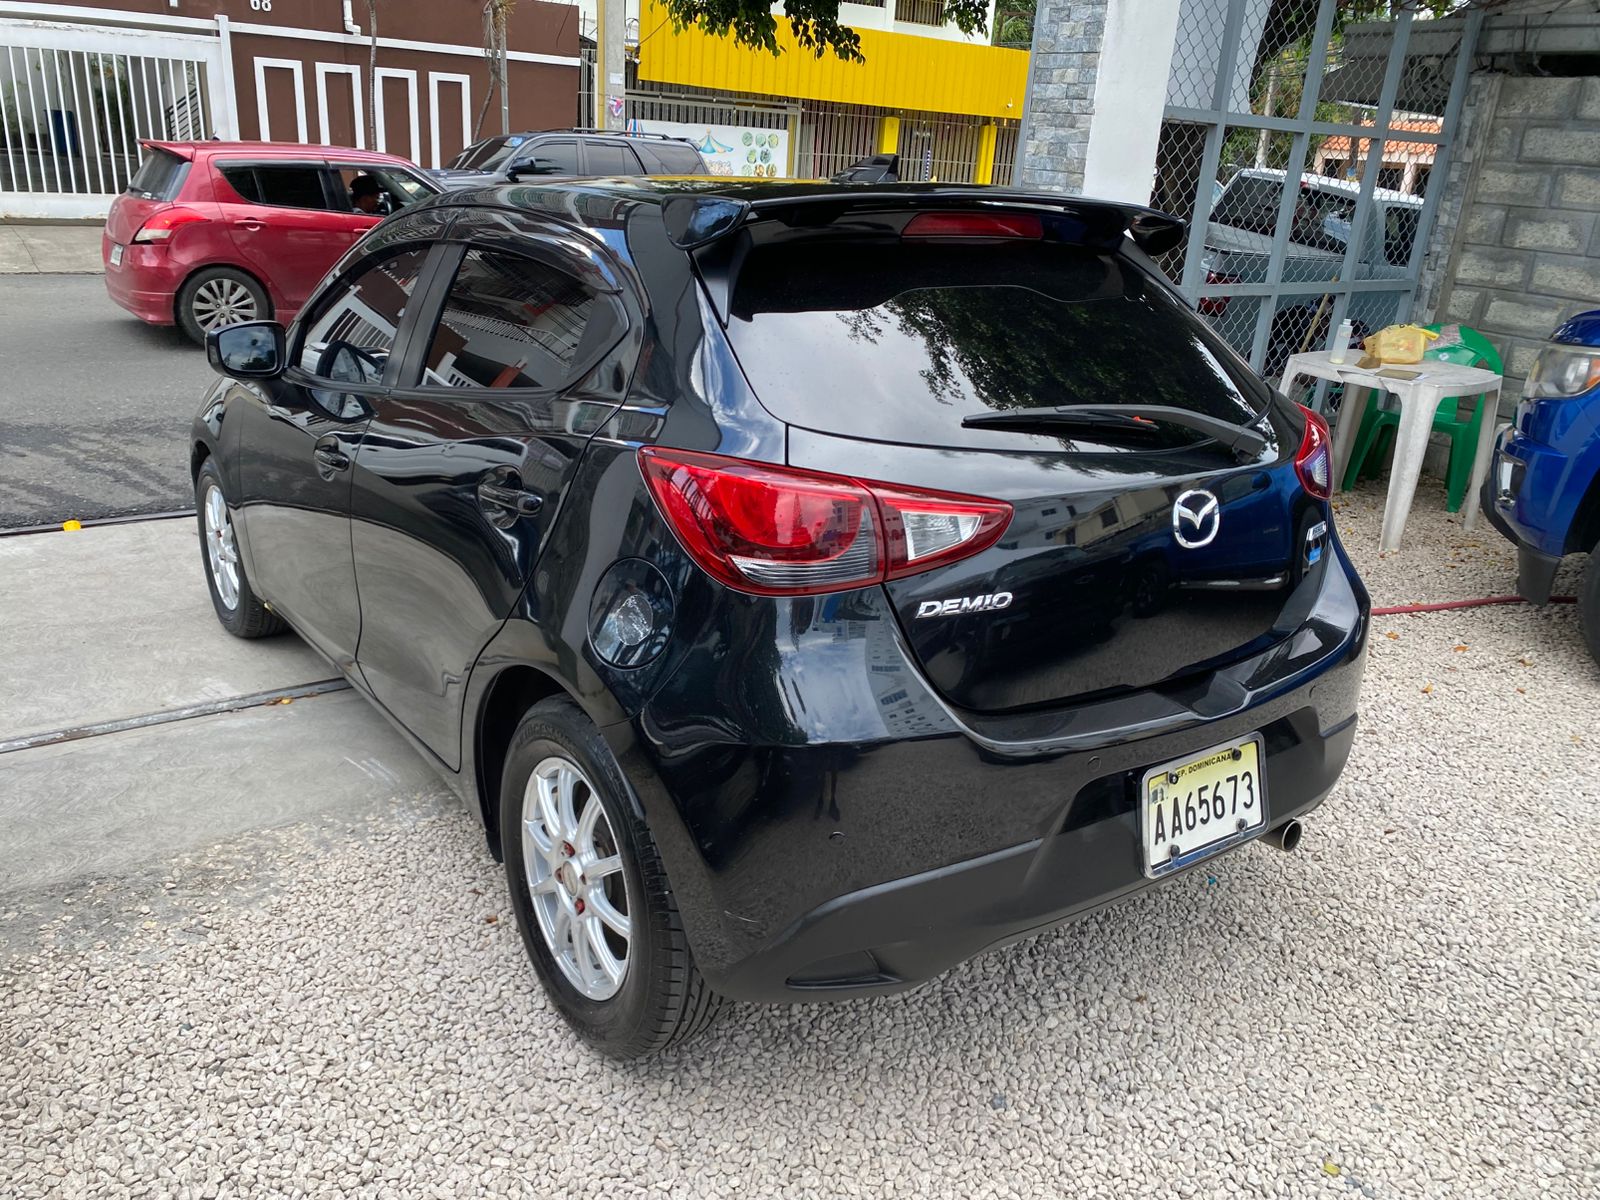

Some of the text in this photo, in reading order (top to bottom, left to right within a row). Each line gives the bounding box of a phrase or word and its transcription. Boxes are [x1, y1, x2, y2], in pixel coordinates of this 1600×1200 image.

[915, 592, 1013, 618] DEMIO
[1188, 752, 1232, 774] DOMINICANA
[1154, 771, 1254, 846] AA65673
